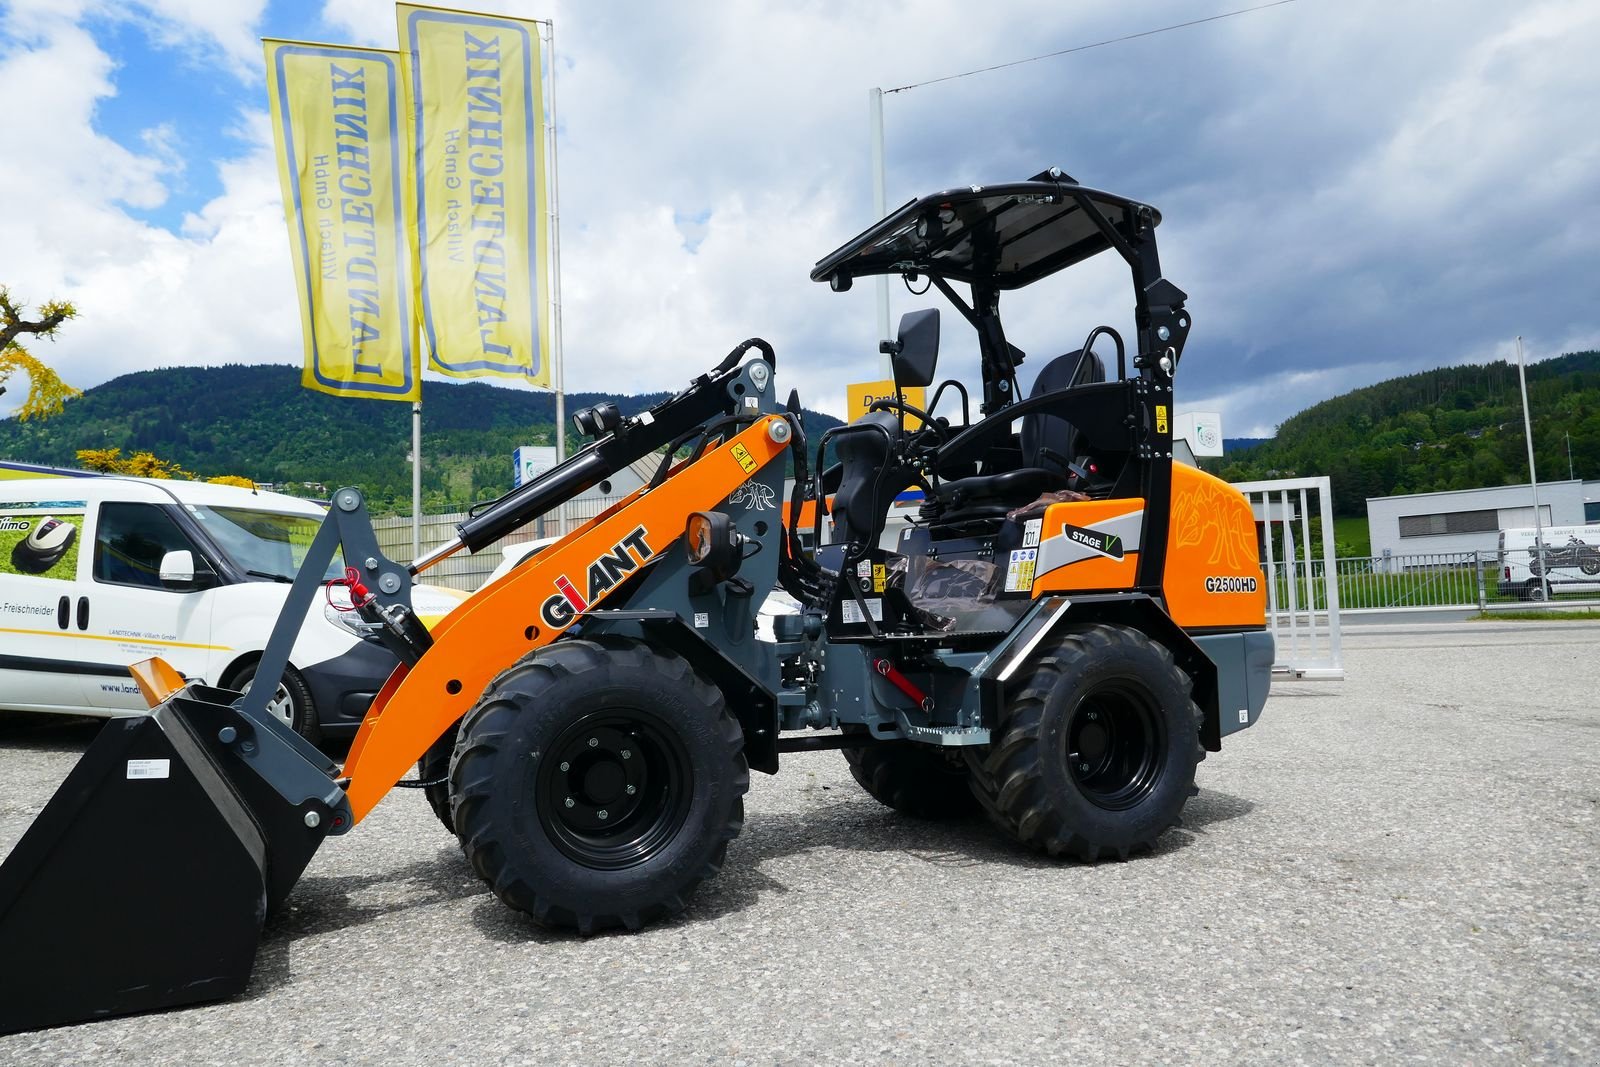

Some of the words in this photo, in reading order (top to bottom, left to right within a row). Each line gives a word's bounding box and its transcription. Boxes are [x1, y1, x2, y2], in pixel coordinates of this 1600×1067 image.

[0, 518, 30, 530] iimo
[1072, 531, 1102, 549] STAGE
[1205, 576, 1257, 593] G2500HD
[4, 602, 54, 616] Freischneider
